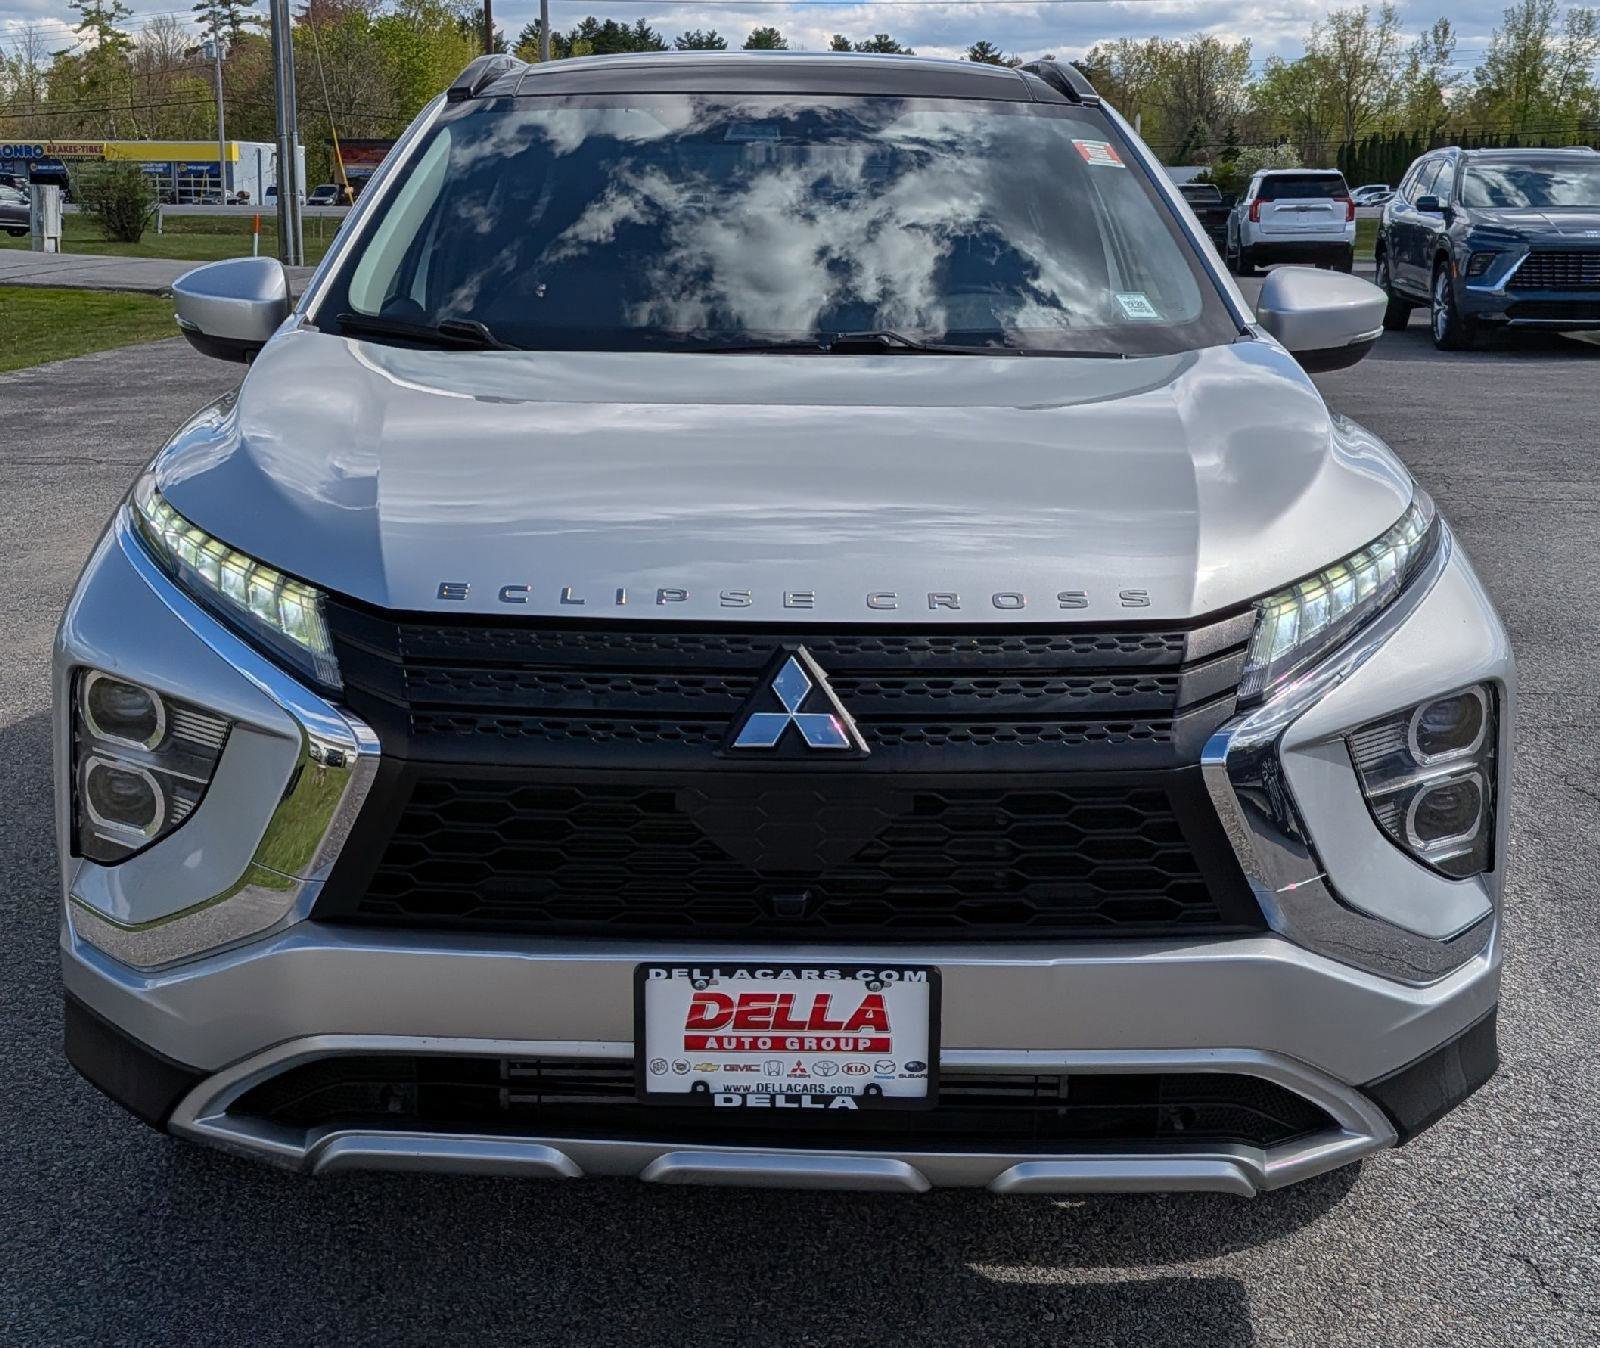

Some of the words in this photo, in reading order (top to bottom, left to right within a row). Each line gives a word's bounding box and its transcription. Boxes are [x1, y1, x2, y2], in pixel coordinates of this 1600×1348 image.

[438, 582, 815, 609] ECLIPSE
[866, 590, 1152, 610] CROSS
[649, 968, 928, 983] DELLACARS.COM
[684, 992, 891, 1033] DELLA
[705, 1037, 772, 1050] AUTO
[785, 1038, 872, 1051] GROUP
[723, 1063, 761, 1072] GMC
[722, 1083, 855, 1095] www.DELLACARS.com
[714, 1094, 859, 1110] DELLA
